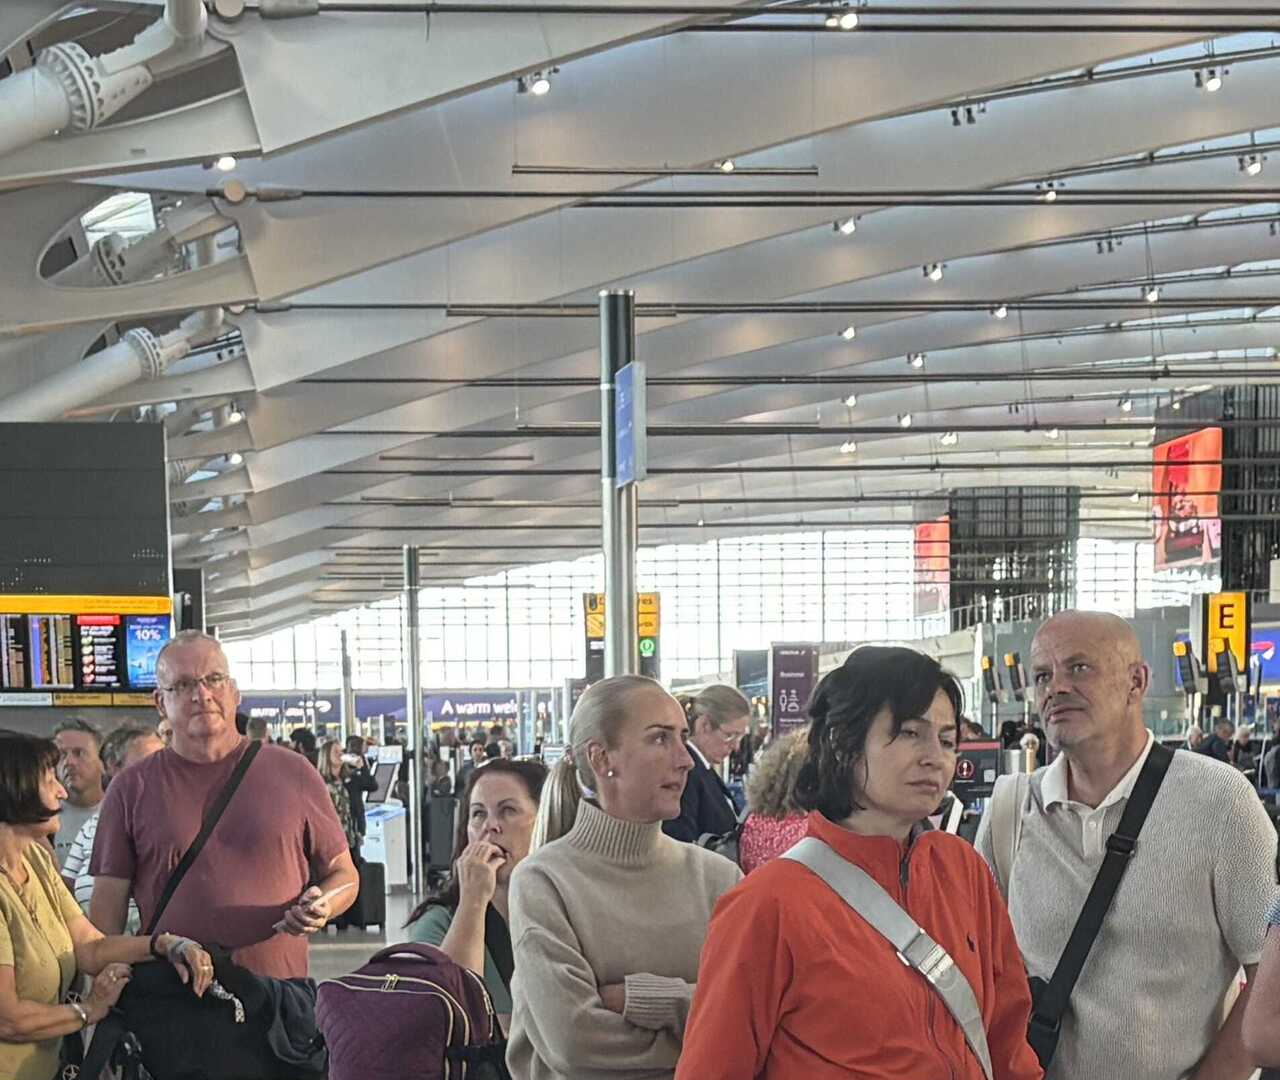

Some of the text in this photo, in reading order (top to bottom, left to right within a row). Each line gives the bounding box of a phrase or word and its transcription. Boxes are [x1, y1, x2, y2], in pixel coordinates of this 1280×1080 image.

[1220, 604, 1234, 629] E
[135, 629, 161, 640] 10%
[441, 700, 454, 714] A
[456, 702, 490, 714] warm
